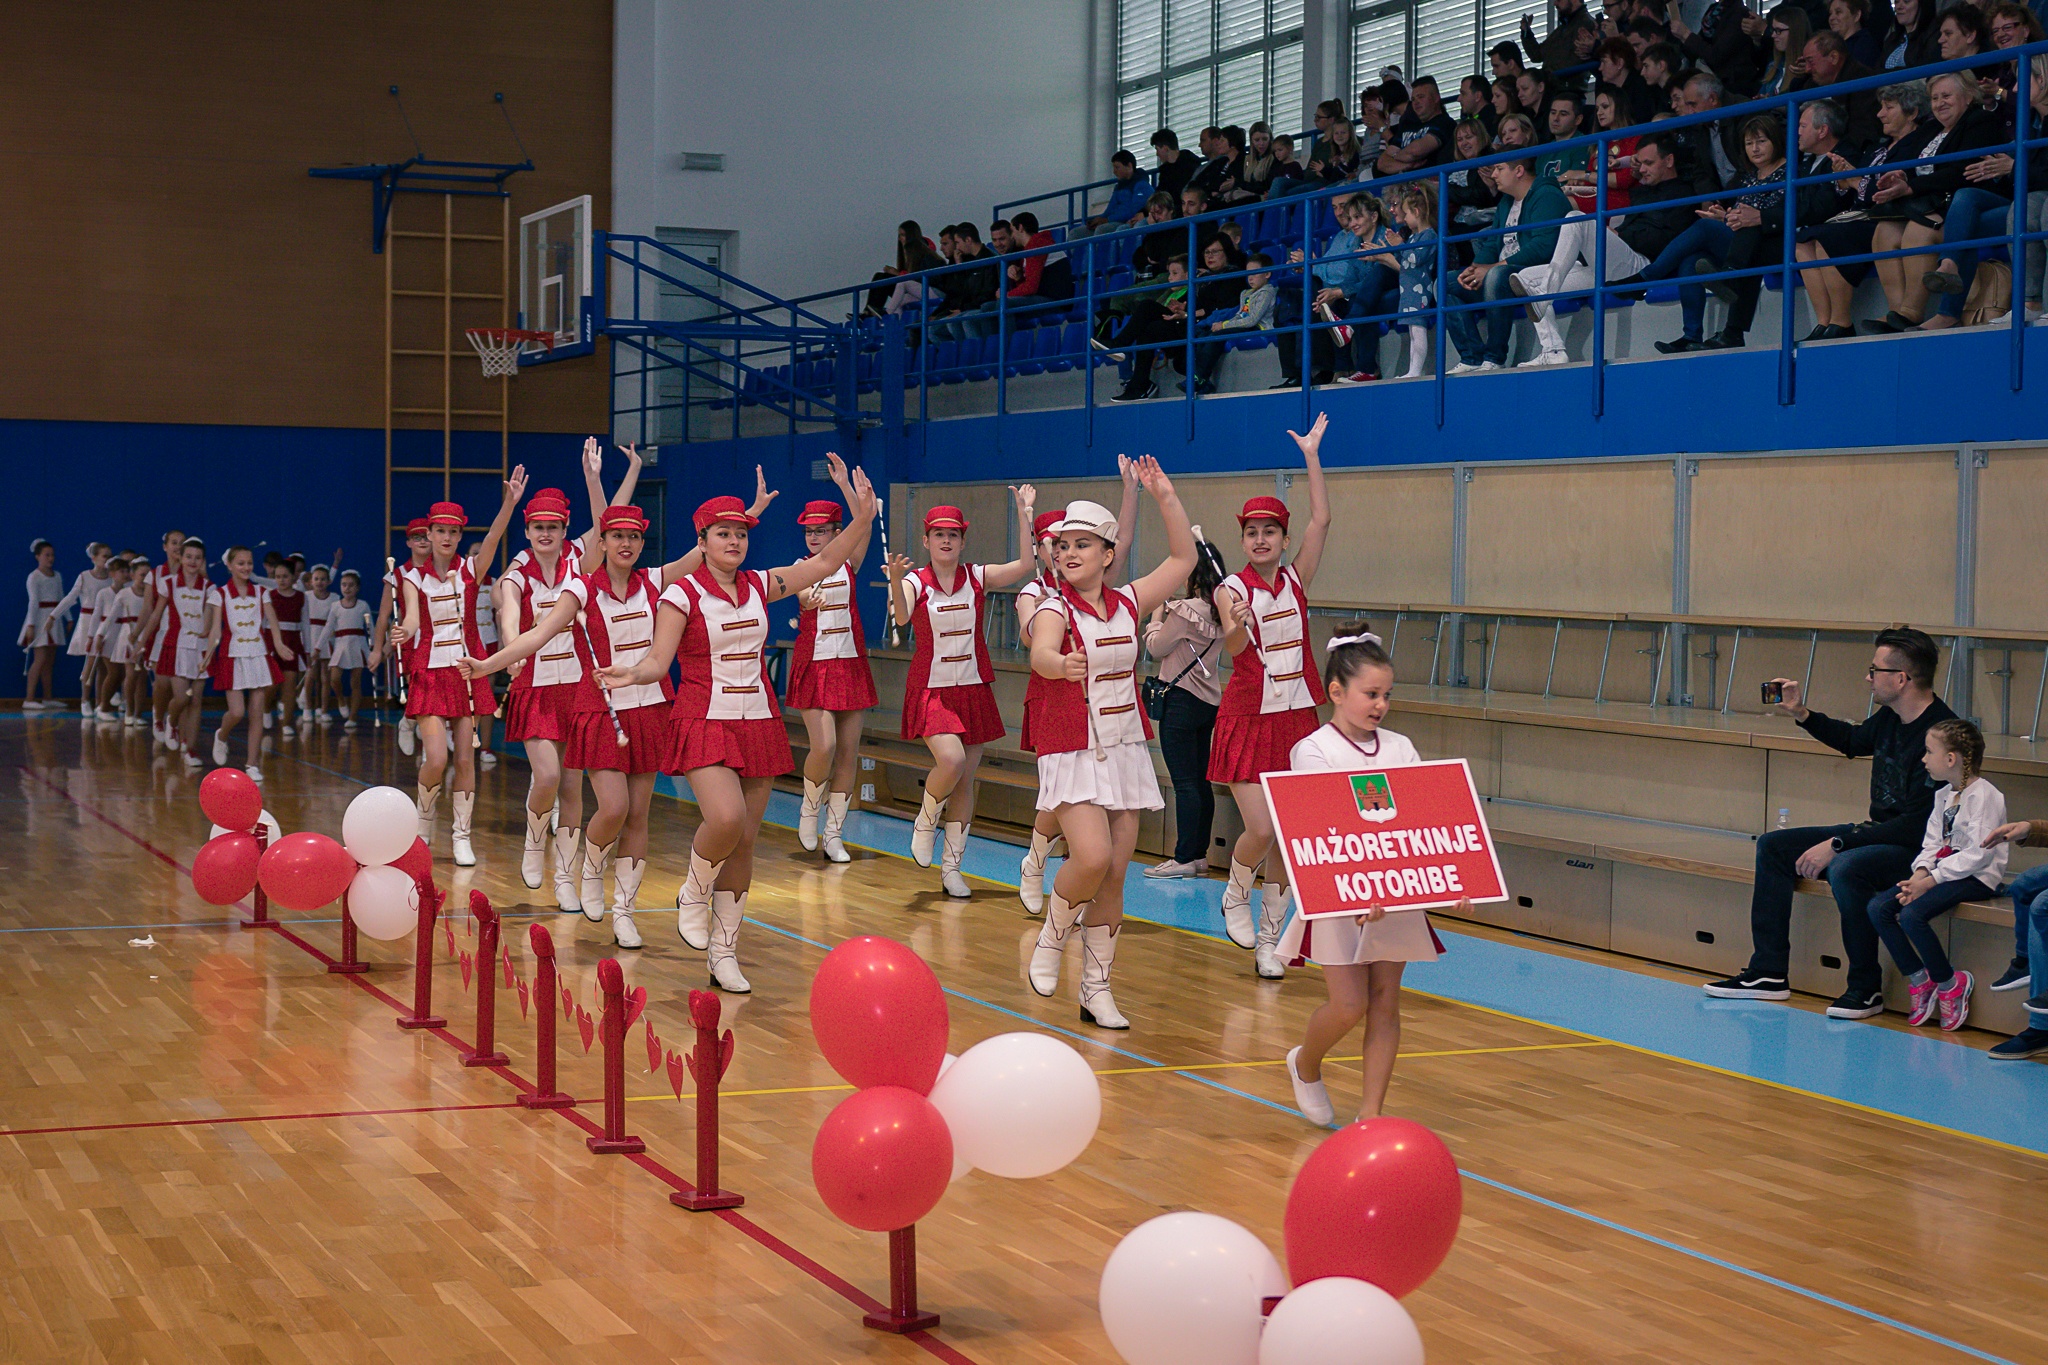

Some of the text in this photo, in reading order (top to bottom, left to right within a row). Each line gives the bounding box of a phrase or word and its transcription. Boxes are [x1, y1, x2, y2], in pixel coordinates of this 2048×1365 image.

[1291, 825, 1483, 867] MAŽORETKINJE
[1565, 859, 1595, 870] elan
[1334, 864, 1463, 902] KOTORIBE
